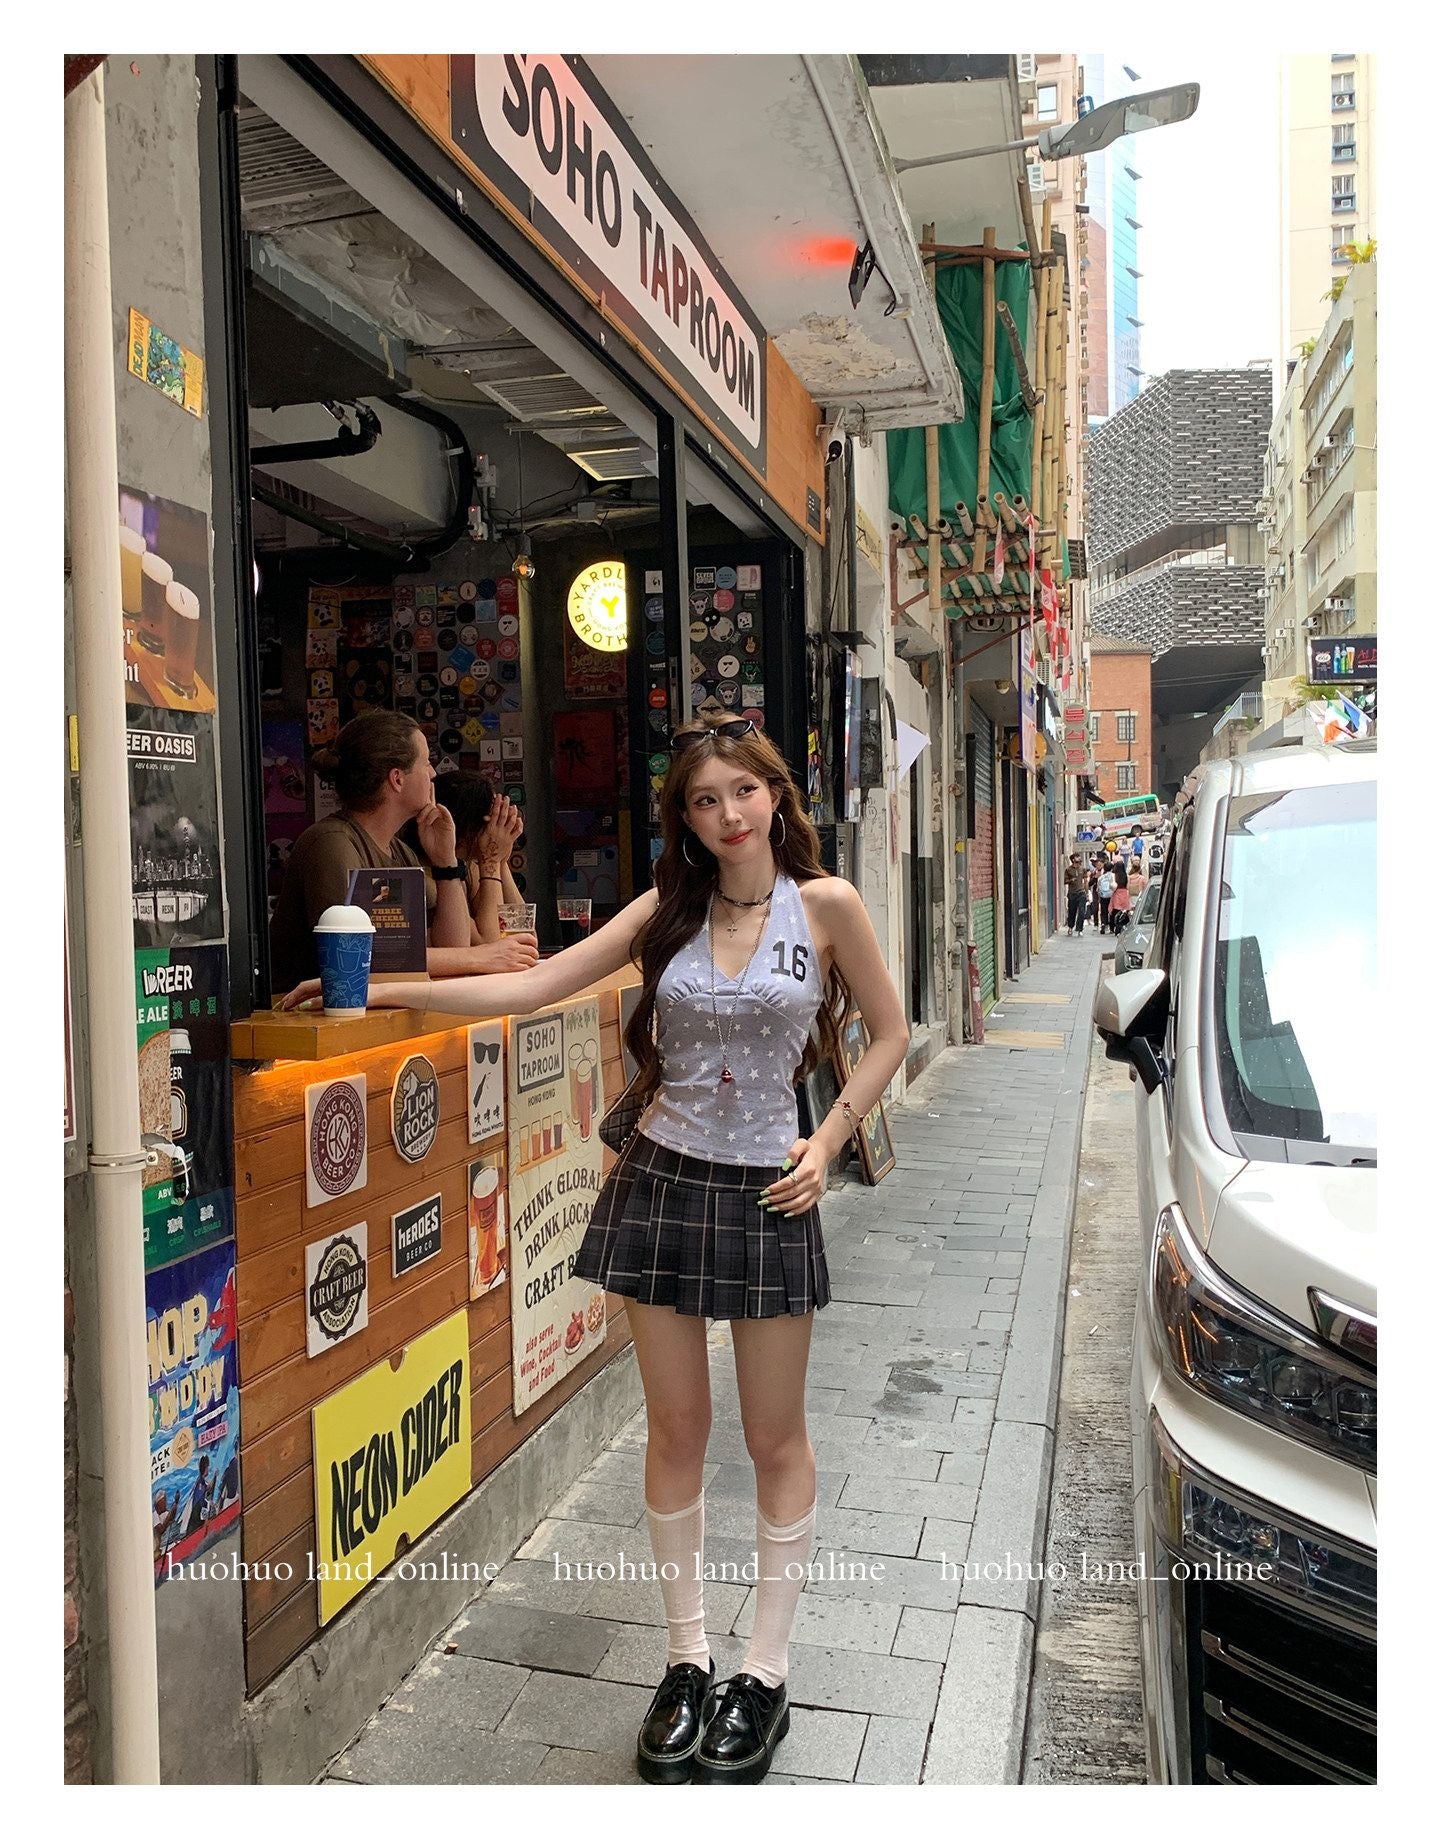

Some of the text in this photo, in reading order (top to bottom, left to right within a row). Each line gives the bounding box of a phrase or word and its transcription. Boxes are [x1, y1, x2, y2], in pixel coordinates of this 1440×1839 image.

[503, 54, 756, 421] SOHO TAPROOM
[133, 341, 144, 376] DEAD
[573, 567, 623, 601] YARDL
[600, 596, 619, 618] Y
[155, 736, 193, 756] OASIS
[771, 941, 808, 982] 16
[147, 1006, 168, 1023] ALE
[526, 1026, 556, 1053] SOHO
[521, 1055, 560, 1080] TAPROOM
[407, 1086, 434, 1118] LION
[528, 1095, 542, 1106] HONG
[319, 1099, 358, 1142] HONG KONG
[404, 1106, 434, 1144] ROCK
[322, 1157, 344, 1178] BEER
[157, 1188, 171, 1199] ABV
[514, 1180, 554, 1241] THINK
[557, 1168, 603, 1195] GLOBAL
[406, 1239, 433, 1262] BEER CO
[525, 1212, 560, 1269] DRINK
[323, 1250, 339, 1274] HONG
[339, 1247, 354, 1263] KONG
[313, 1282, 341, 1305] CRAFT
[342, 1268, 364, 1293] BEER
[525, 1260, 565, 1309] CRAFT
[323, 1298, 355, 1327] ASSOCIATION
[146, 1293, 208, 1386] HOP
[539, 1324, 553, 1343] serve
[529, 1359, 555, 1392] and Food
[331, 1359, 463, 1562] NEON CIDER
